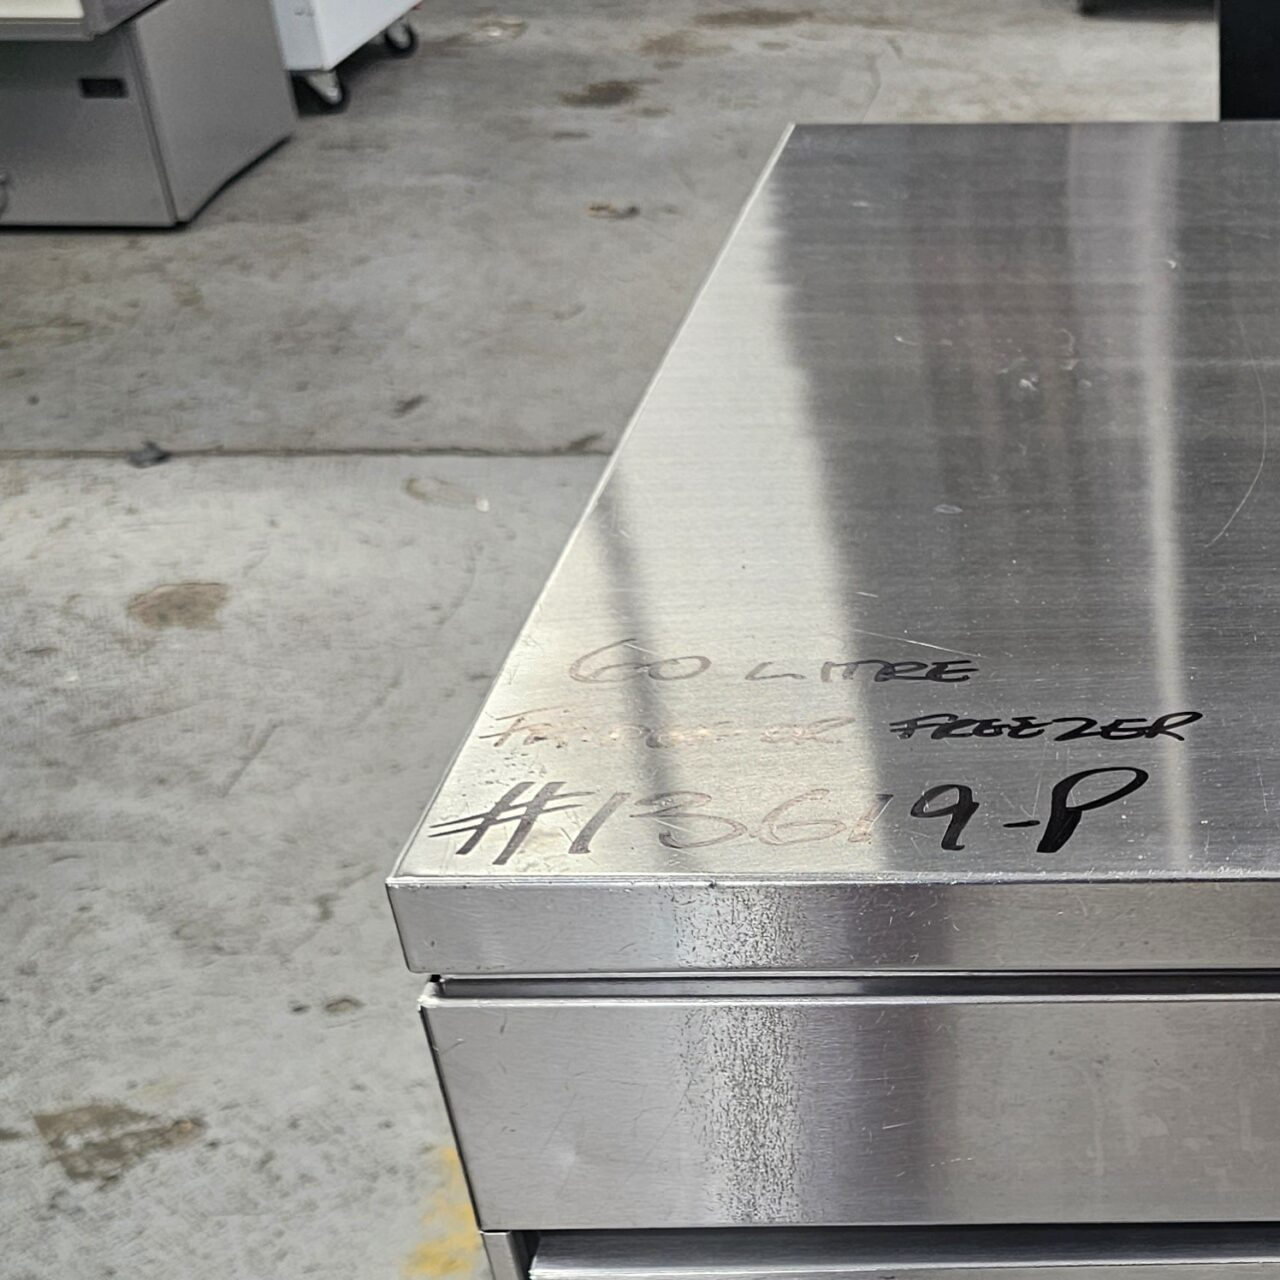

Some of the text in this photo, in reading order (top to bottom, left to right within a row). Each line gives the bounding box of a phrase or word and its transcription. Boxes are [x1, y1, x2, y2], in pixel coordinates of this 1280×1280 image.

[568, 638, 979, 685] 60 LITRE
[890, 711, 1203, 742] FREEZER
